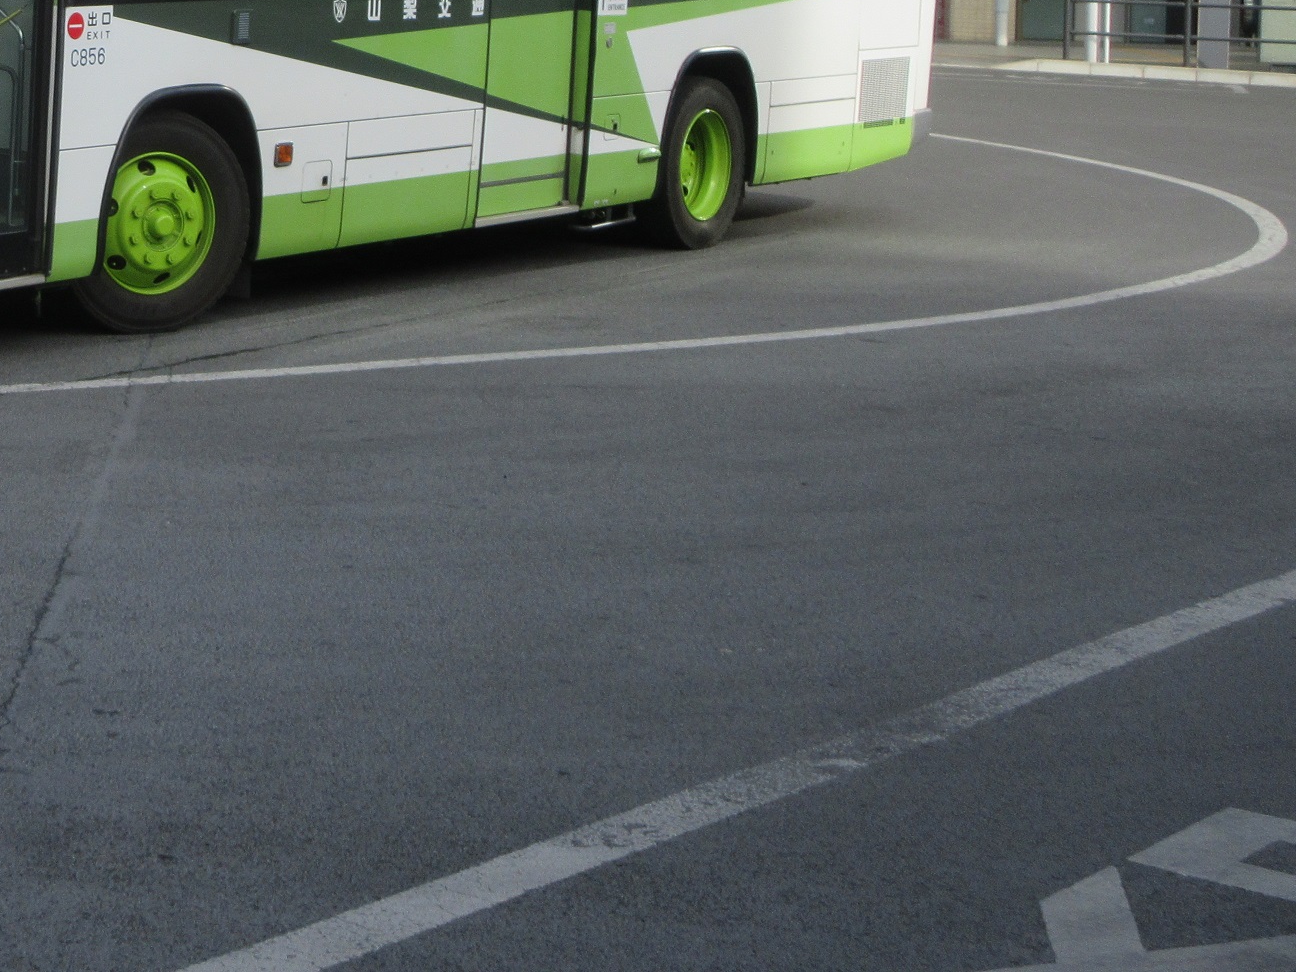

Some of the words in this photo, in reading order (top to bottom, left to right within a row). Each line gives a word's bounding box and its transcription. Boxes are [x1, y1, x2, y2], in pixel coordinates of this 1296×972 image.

[87, 11, 111, 26] 出口
[86, 30, 111, 40] EXIT
[70, 47, 106, 67] C856
